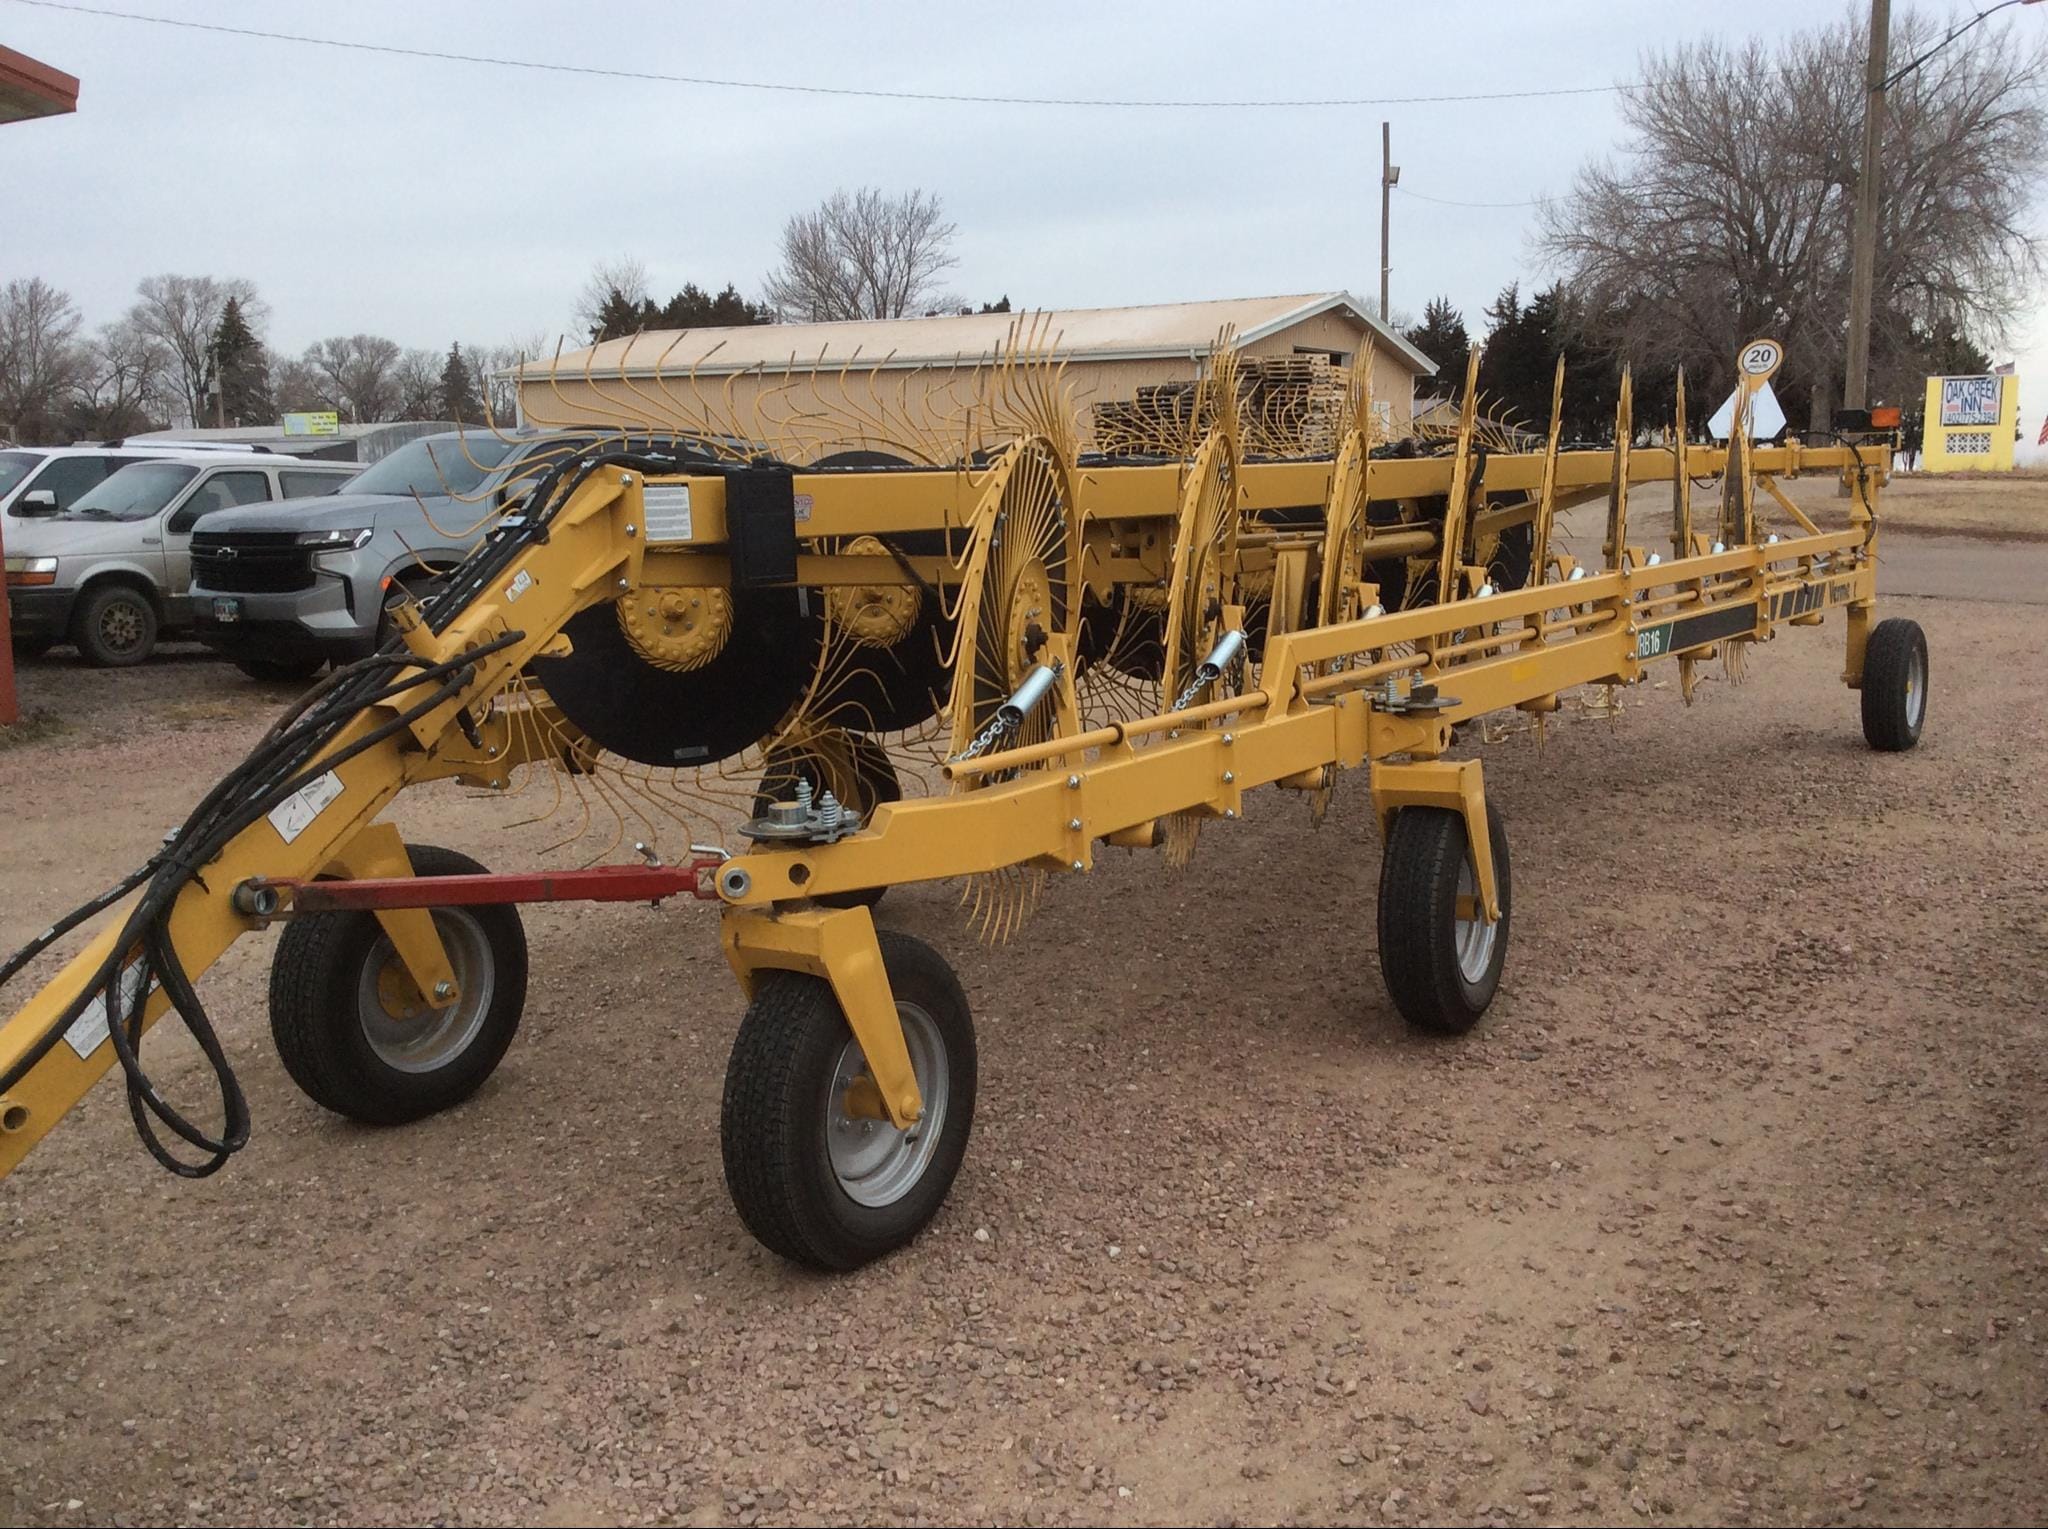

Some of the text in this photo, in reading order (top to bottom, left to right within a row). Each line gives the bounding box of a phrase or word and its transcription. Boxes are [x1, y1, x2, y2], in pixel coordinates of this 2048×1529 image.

[1749, 349, 1771, 363] 20
[1946, 380, 1998, 404] OAK CREEK
[1961, 396, 1982, 413] INN
[1638, 629, 1660, 657] RB16
